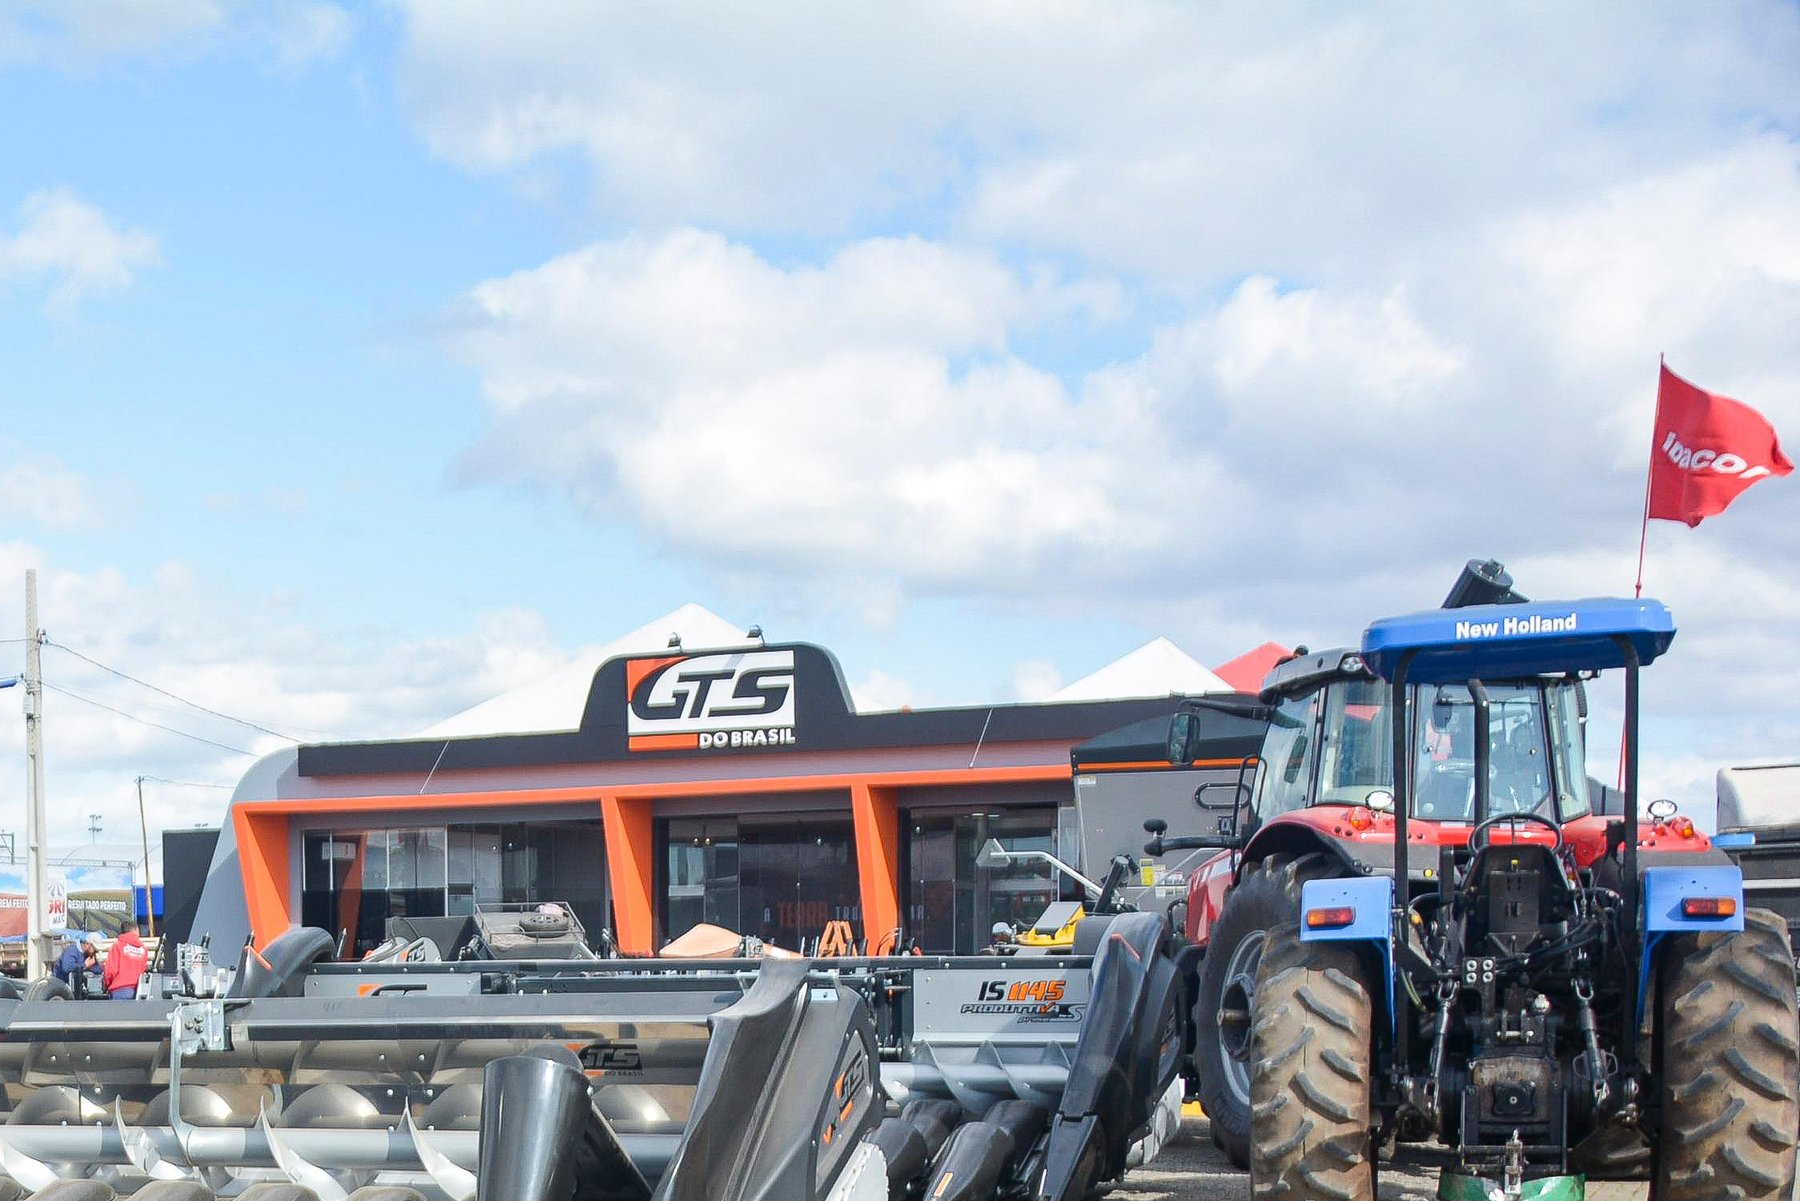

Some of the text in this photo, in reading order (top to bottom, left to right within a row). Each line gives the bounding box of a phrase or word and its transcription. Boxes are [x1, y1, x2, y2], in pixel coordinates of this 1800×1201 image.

[1456, 612, 1577, 639] New Holland
[629, 652, 795, 722] GTS
[699, 727, 796, 749] DO BRASIL
[99, 900, 127, 911] PERFEITO
[978, 980, 1066, 1001] IS 1145
[579, 1043, 643, 1070] GTS
